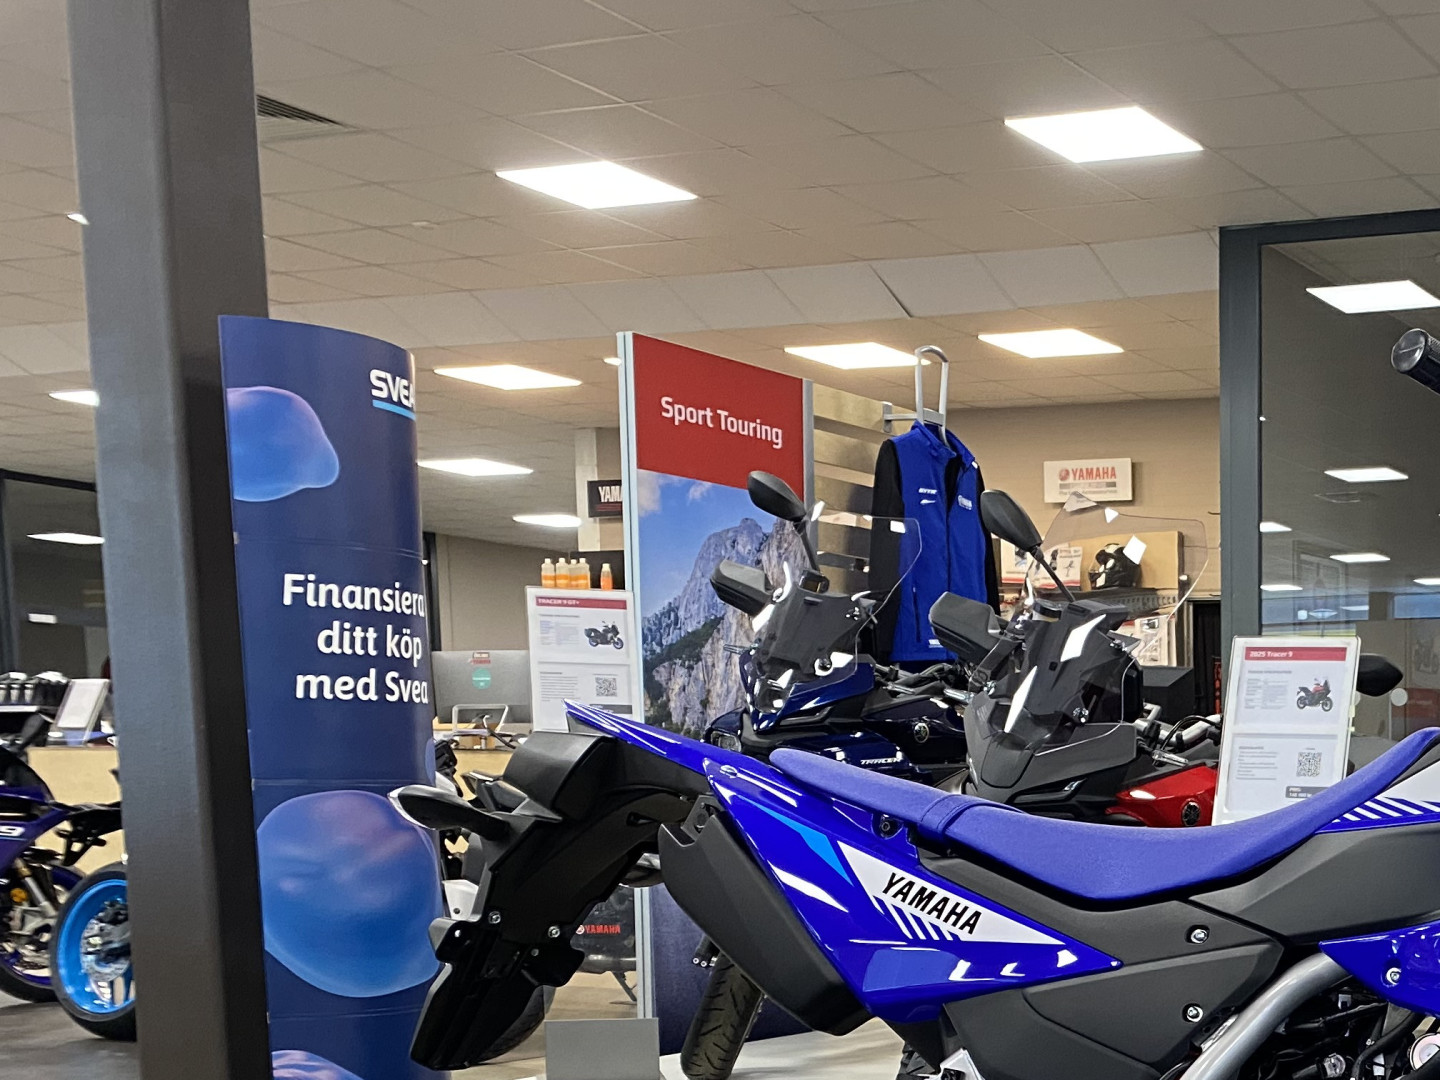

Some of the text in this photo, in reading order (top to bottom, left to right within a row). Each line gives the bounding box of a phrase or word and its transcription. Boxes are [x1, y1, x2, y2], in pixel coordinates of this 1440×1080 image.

[660, 396, 783, 449] Sport Touring
[1071, 466, 1117, 480] YAMAHA
[598, 486, 623, 502] YAM
[282, 573, 425, 618] Finansiera
[316, 620, 423, 668] ditt köp
[295, 668, 429, 704] med Svea
[882, 872, 982, 935] YAMAHA
[585, 925, 620, 934] YAMAHA
